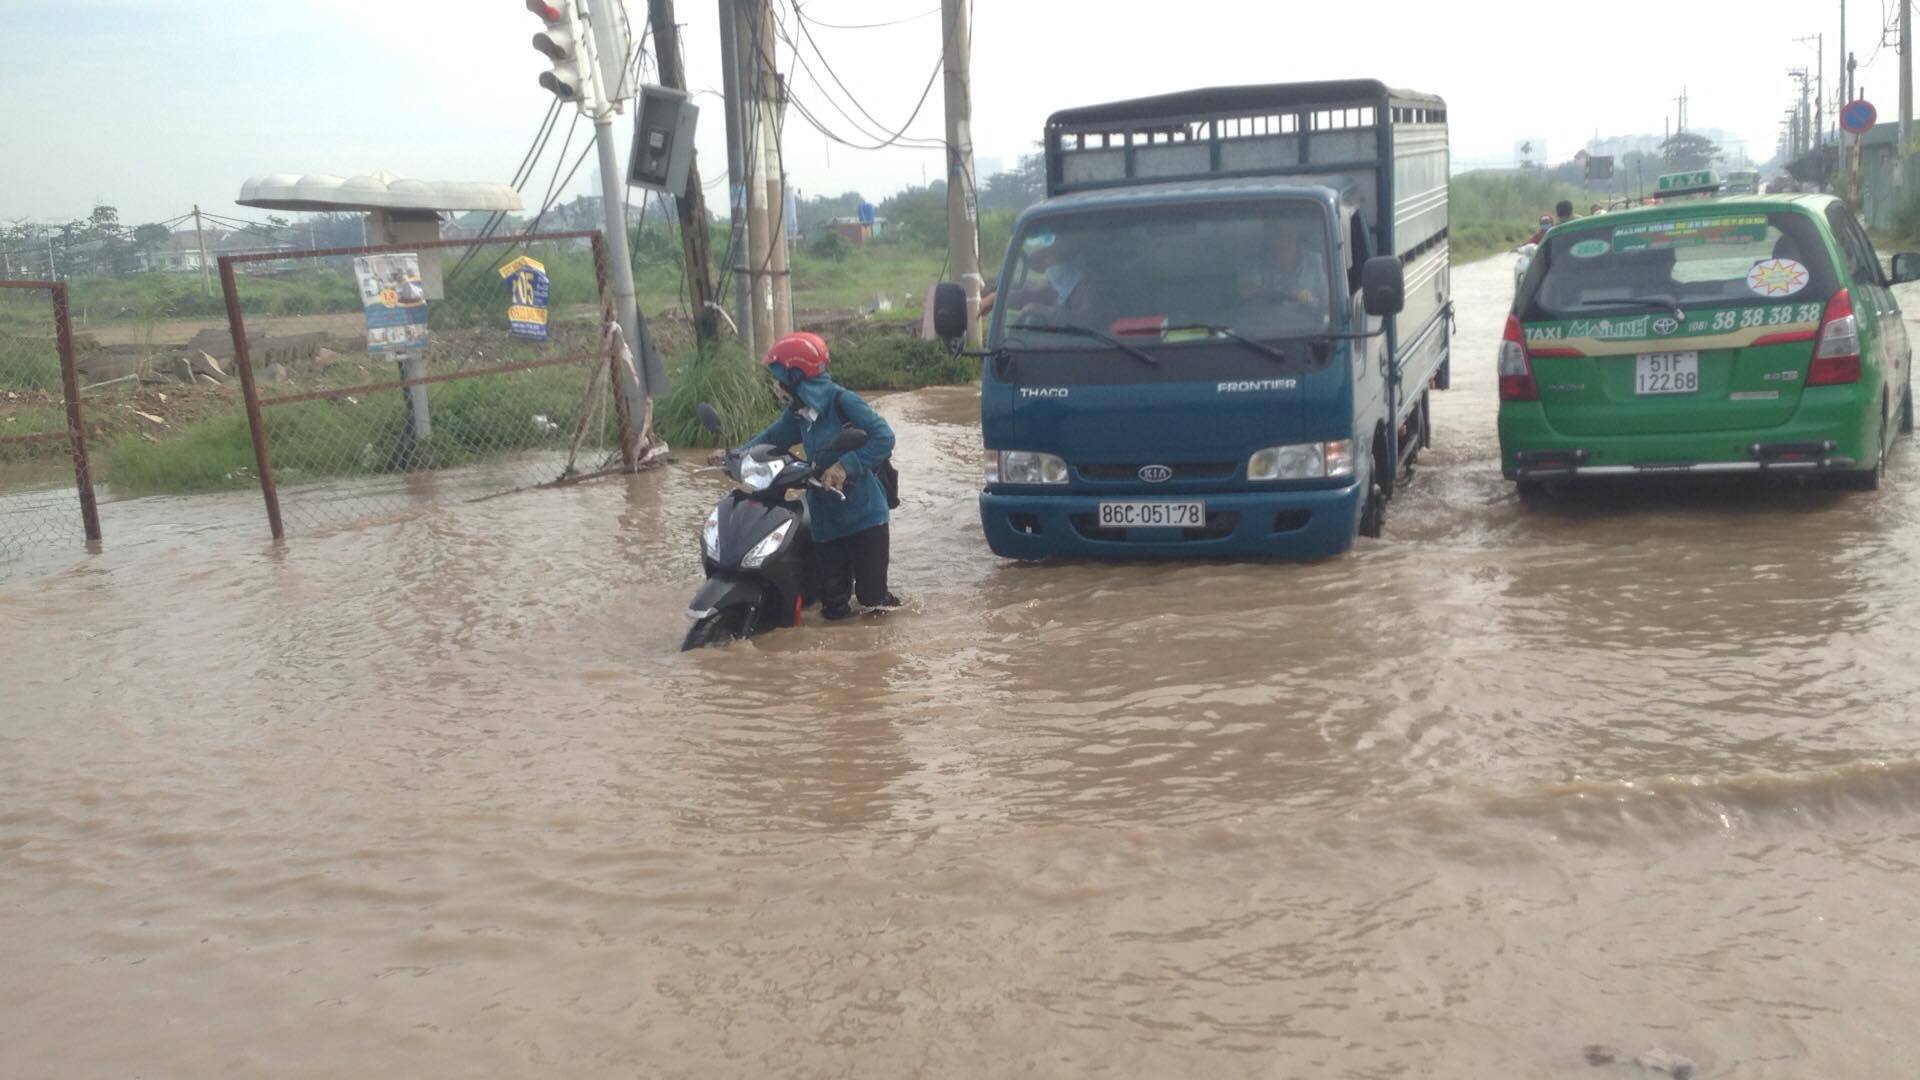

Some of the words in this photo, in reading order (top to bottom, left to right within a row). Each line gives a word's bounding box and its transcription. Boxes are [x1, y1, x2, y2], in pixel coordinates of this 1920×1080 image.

[1525, 327, 1562, 340] TAXI
[1712, 310, 1736, 330] 38
[1740, 308, 1764, 327] 38
[1768, 305, 1792, 325] 38
[1797, 303, 1820, 323] 38
[1650, 353, 1683, 372] 51F
[1217, 379, 1297, 393] FRONTIER
[1639, 372, 1697, 392] 122.68
[1020, 387, 1069, 398] THACO
[1144, 468, 1167, 479] KIA
[1102, 504, 1200, 524] 86C-051.78
